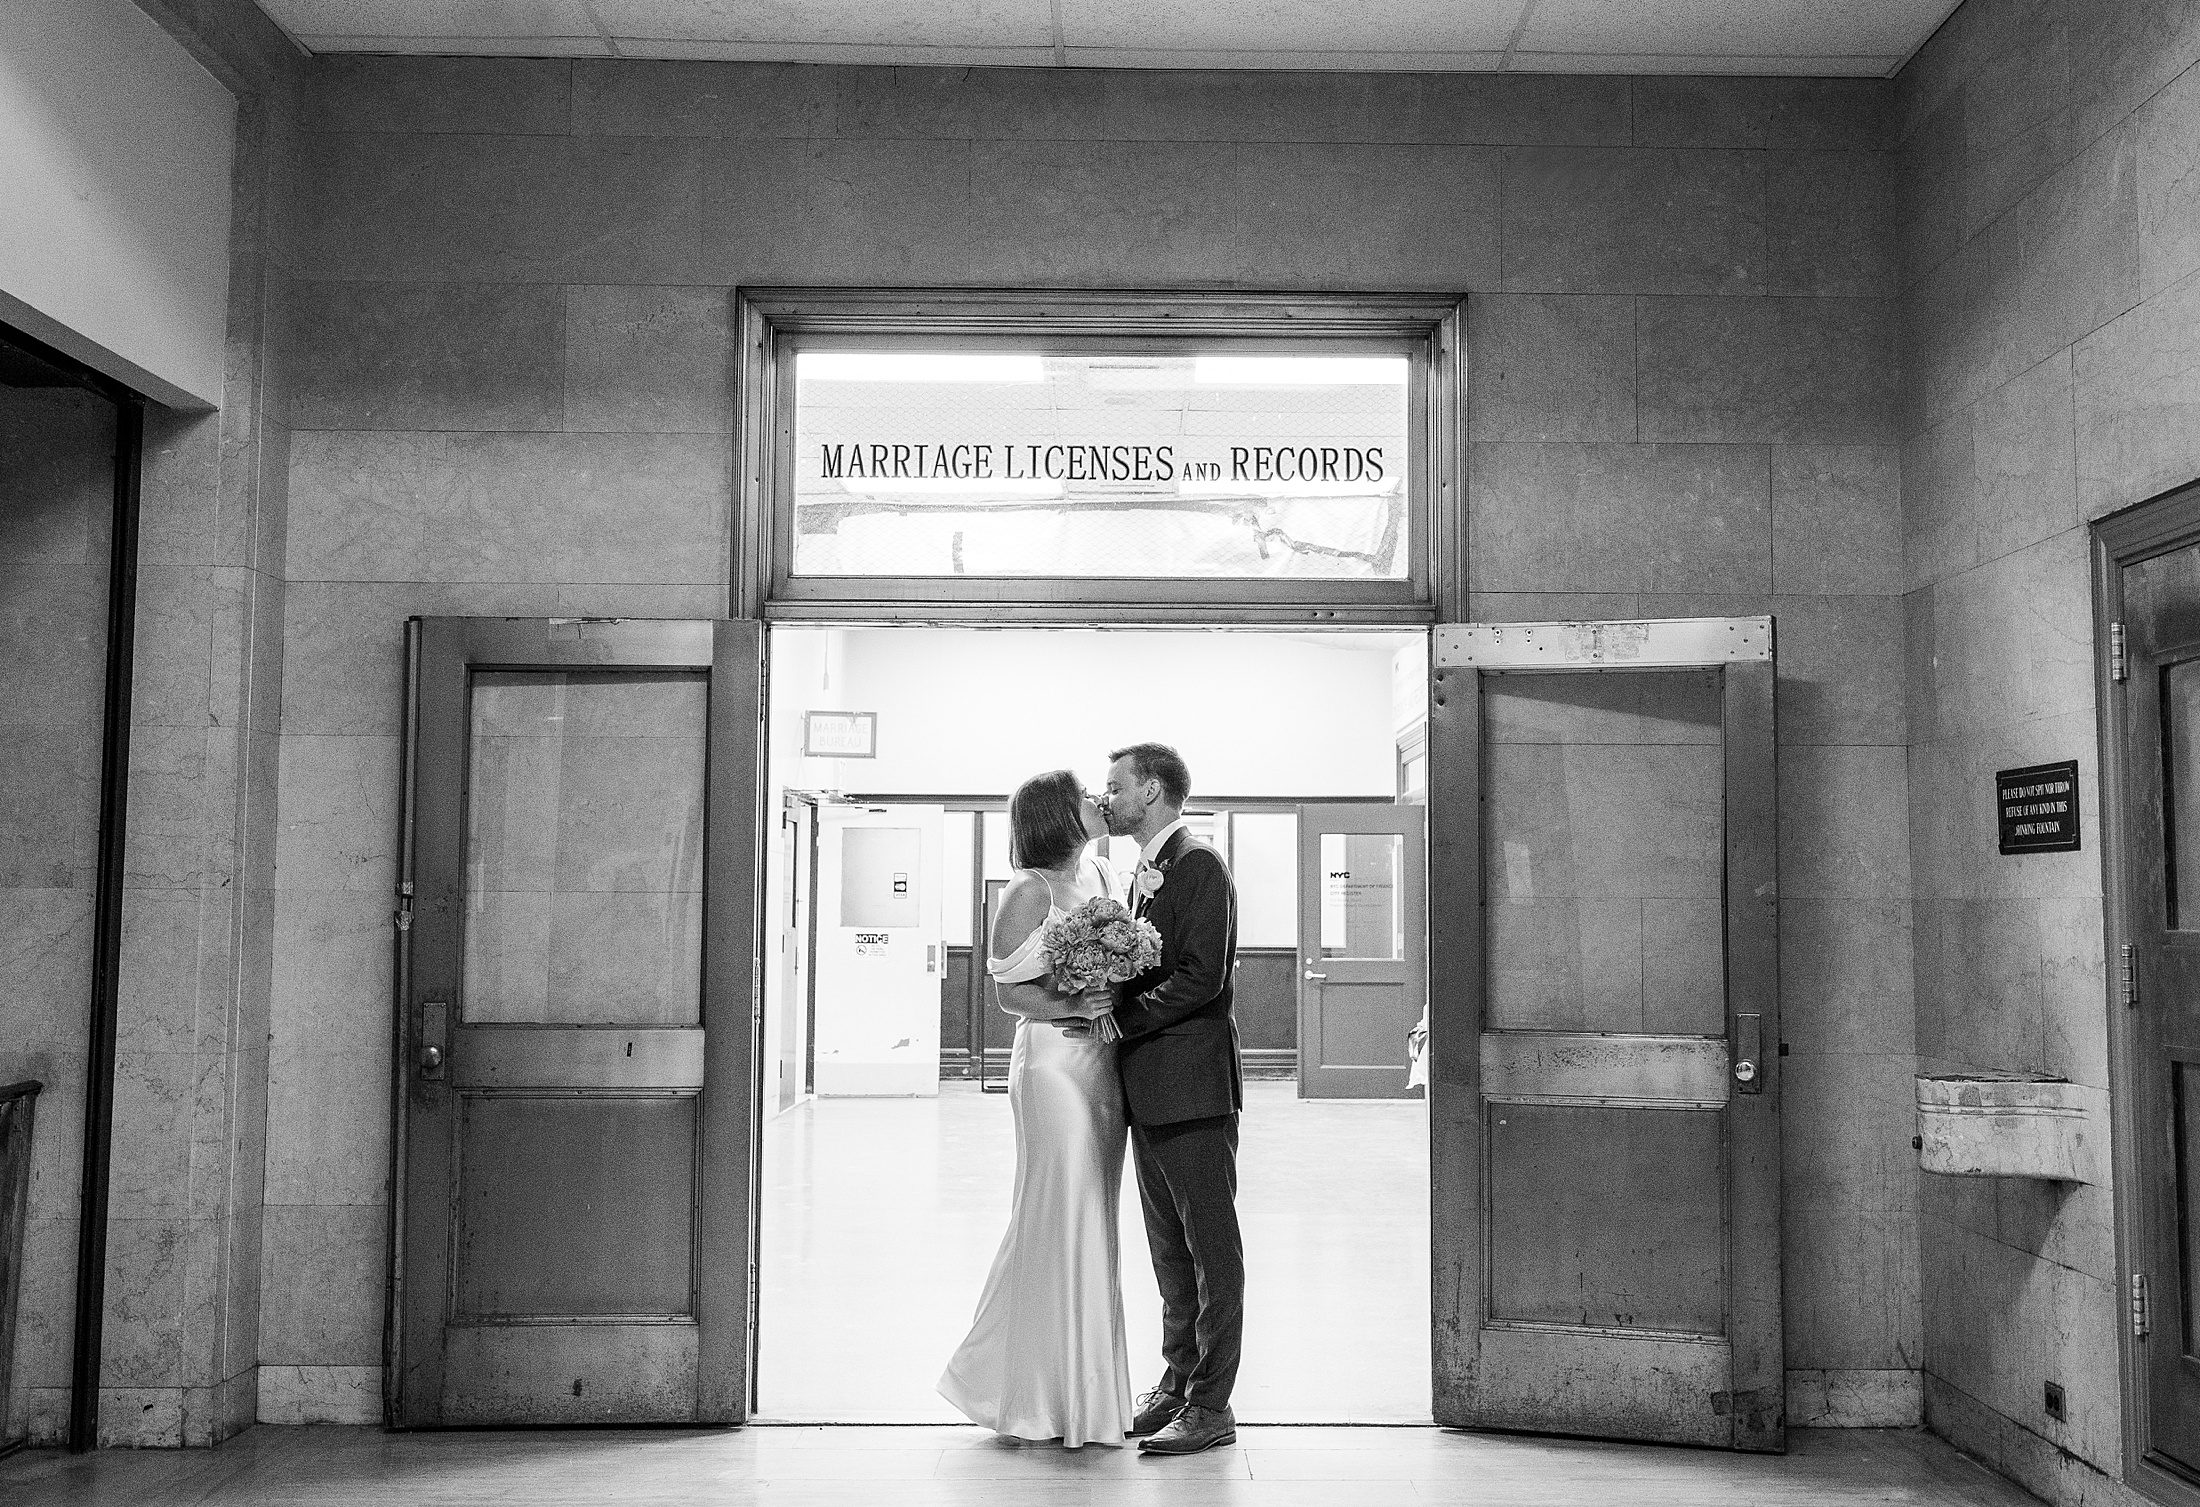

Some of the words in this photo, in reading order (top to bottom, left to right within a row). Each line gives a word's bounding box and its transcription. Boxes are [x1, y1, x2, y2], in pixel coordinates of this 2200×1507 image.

[821, 443, 993, 478] MARRIAGE
[1004, 445, 1174, 481] LICENSES
[1182, 462, 1222, 481] AND
[1230, 446, 1384, 481] RECORDS
[814, 722, 868, 734] MARRIAGE
[819, 736, 862, 748] BUREAU
[2003, 788, 2018, 800] PLEASE
[2019, 786, 2026, 798] DO
[2026, 785, 2034, 796] NOT
[2035, 784, 2044, 796] SPIT
[2045, 782, 2054, 794] NOR
[2055, 781, 2069, 793] THROW
[2006, 806, 2022, 818] REFUSE
[2023, 804, 2029, 816] OF
[2029, 803, 2038, 815] ANY
[2039, 802, 2050, 814] KIND
[2050, 802, 2056, 813] IN
[2056, 800, 2067, 813] THIS
[2037, 821, 2060, 834] FOUNTAIN
[855, 934, 888, 943] NOTICE
